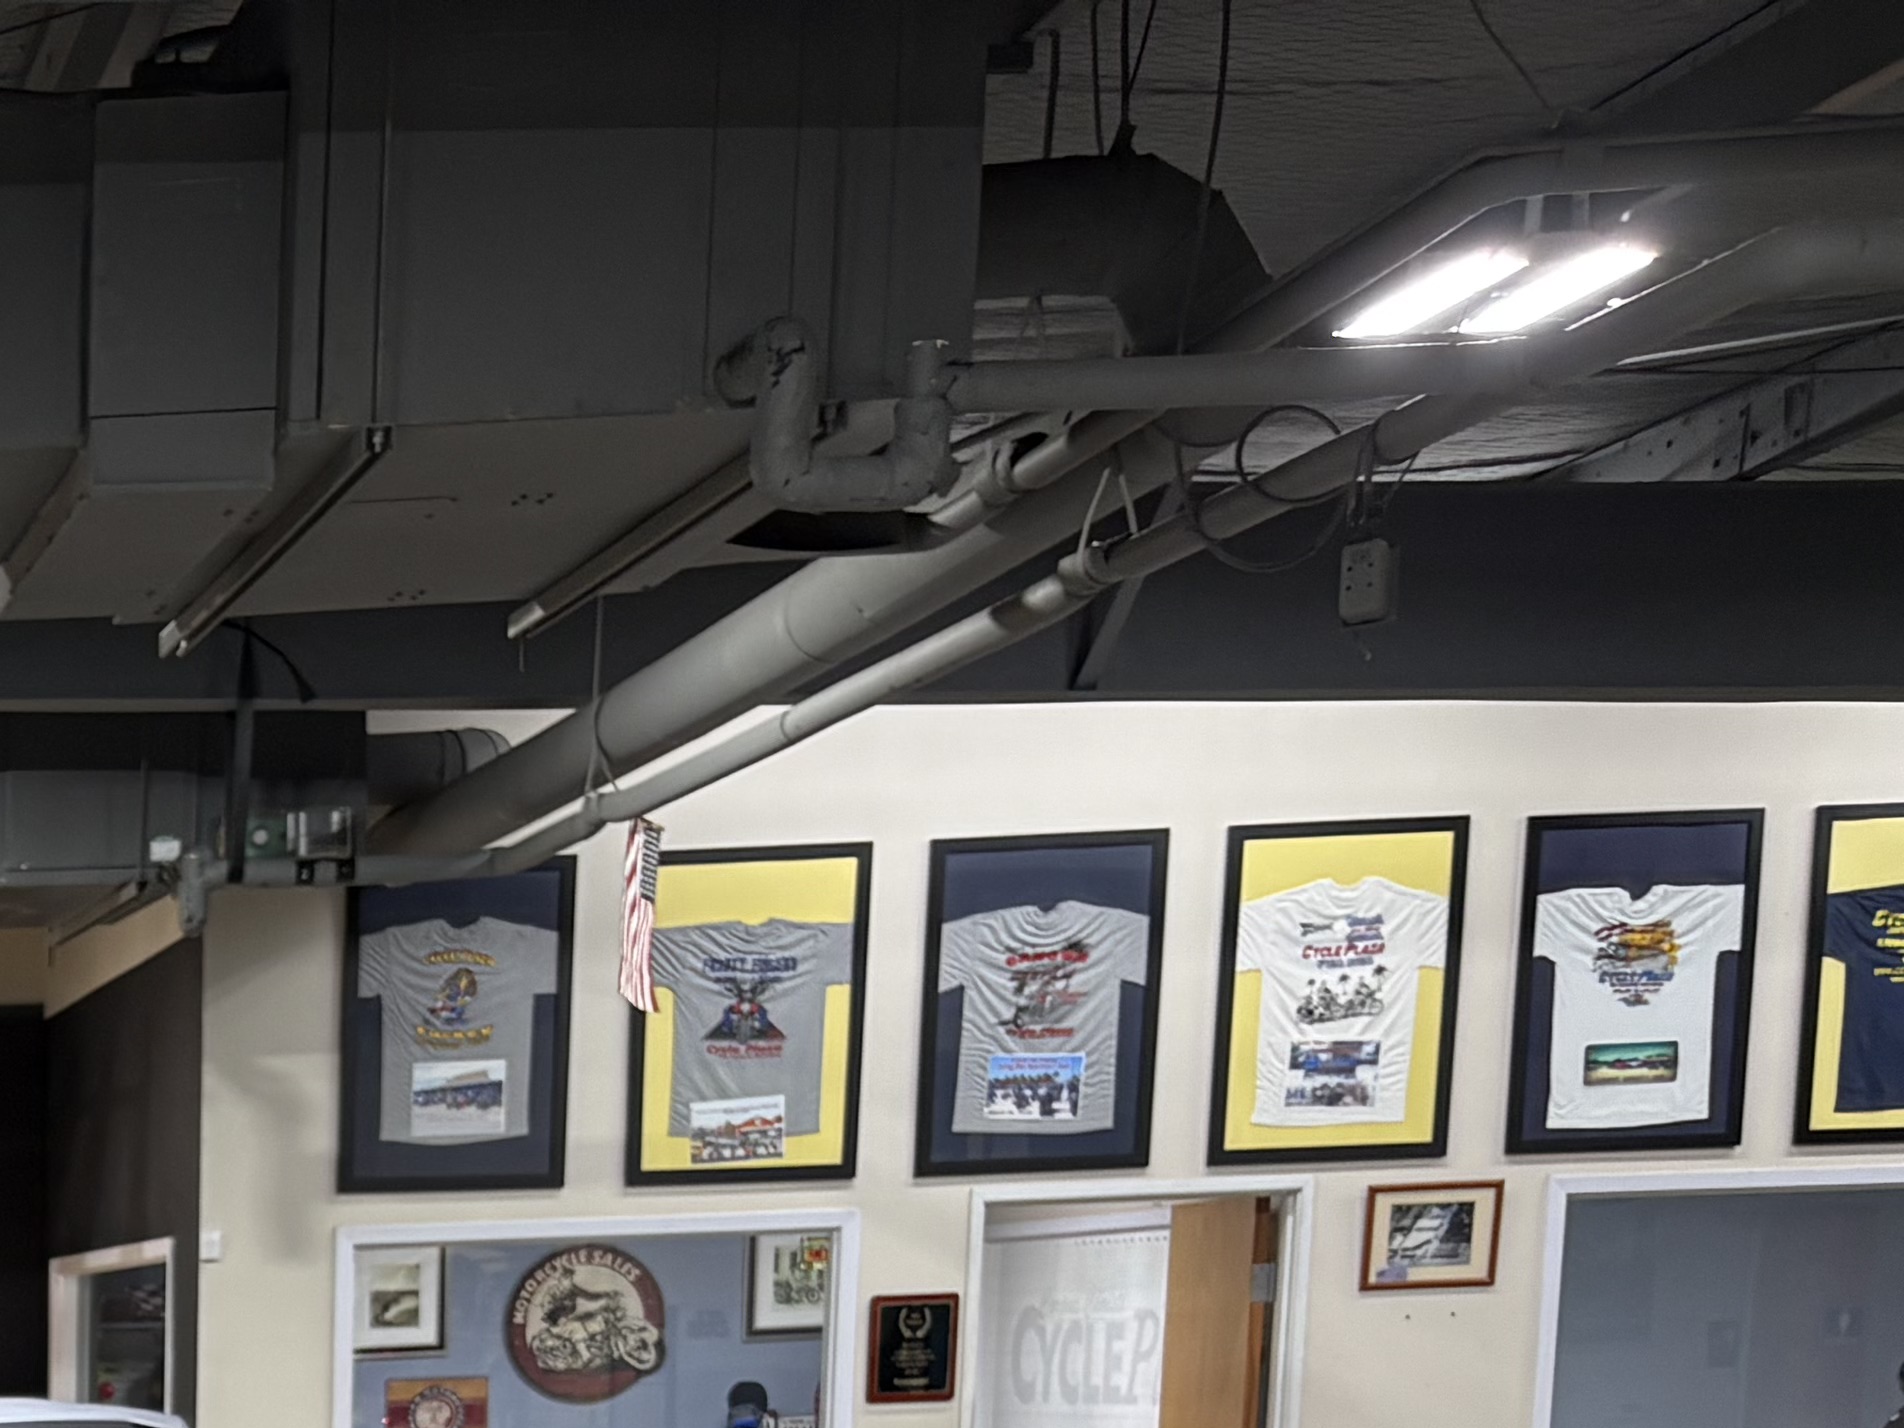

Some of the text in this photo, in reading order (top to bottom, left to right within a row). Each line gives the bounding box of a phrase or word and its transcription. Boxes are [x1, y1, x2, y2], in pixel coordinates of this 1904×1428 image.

[512, 1249, 642, 1325] MOTORCYCLE SALES
[1011, 1304, 1138, 1405] CYCLE
